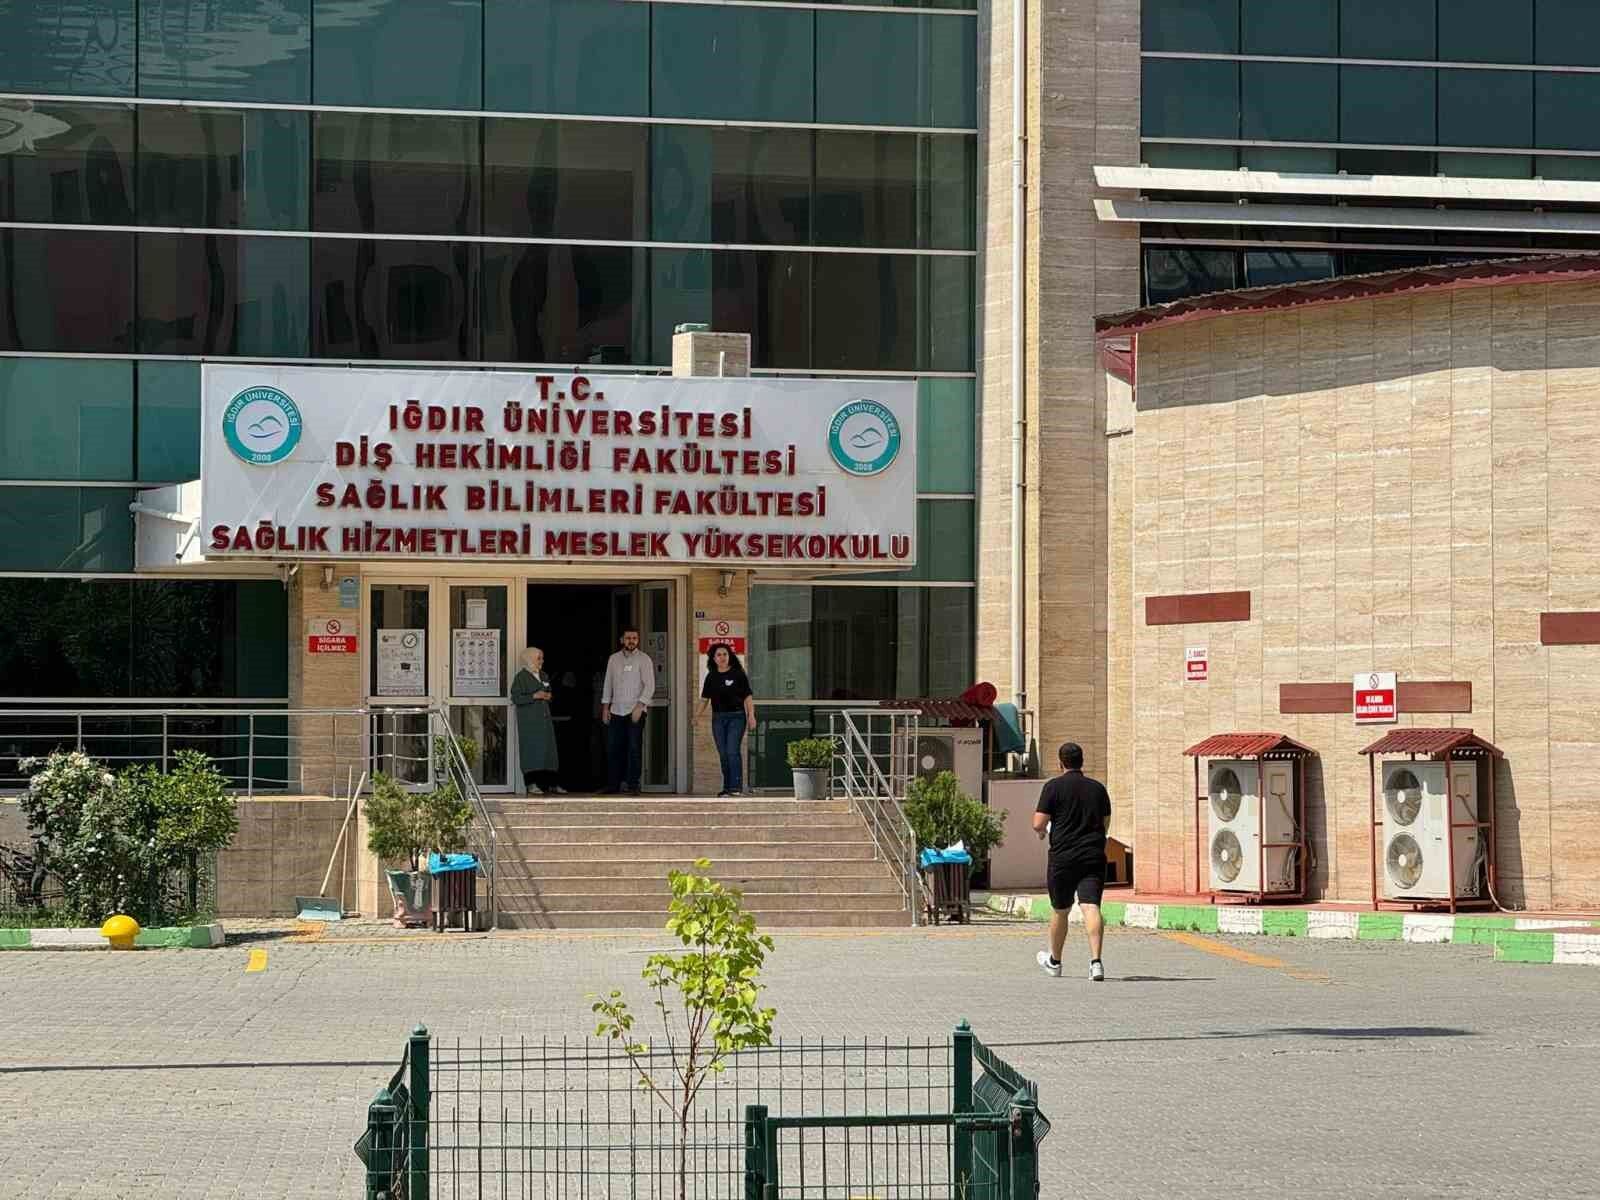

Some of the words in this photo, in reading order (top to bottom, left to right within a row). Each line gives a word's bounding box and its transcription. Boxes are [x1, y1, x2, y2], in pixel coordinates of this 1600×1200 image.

[536, 376, 603, 401] T.C.
[390, 400, 484, 433] IĞDIR
[504, 401, 752, 438] ÜNİVERSİTESİ
[336, 435, 393, 471] DİŞ
[416, 437, 591, 472] HEKİMLİĞİ
[613, 443, 796, 476] FAKÜLTESİ
[316, 479, 448, 511] SAĞLIK
[465, 480, 643, 515] BİLİMLERİ
[655, 484, 826, 517] FAKÜLTESİ
[210, 520, 330, 552] SAĞLIK
[342, 520, 531, 556] HİZMETLERİ
[545, 531, 671, 558] MESLEK
[684, 527, 910, 560] YÜKSEKOKULU
